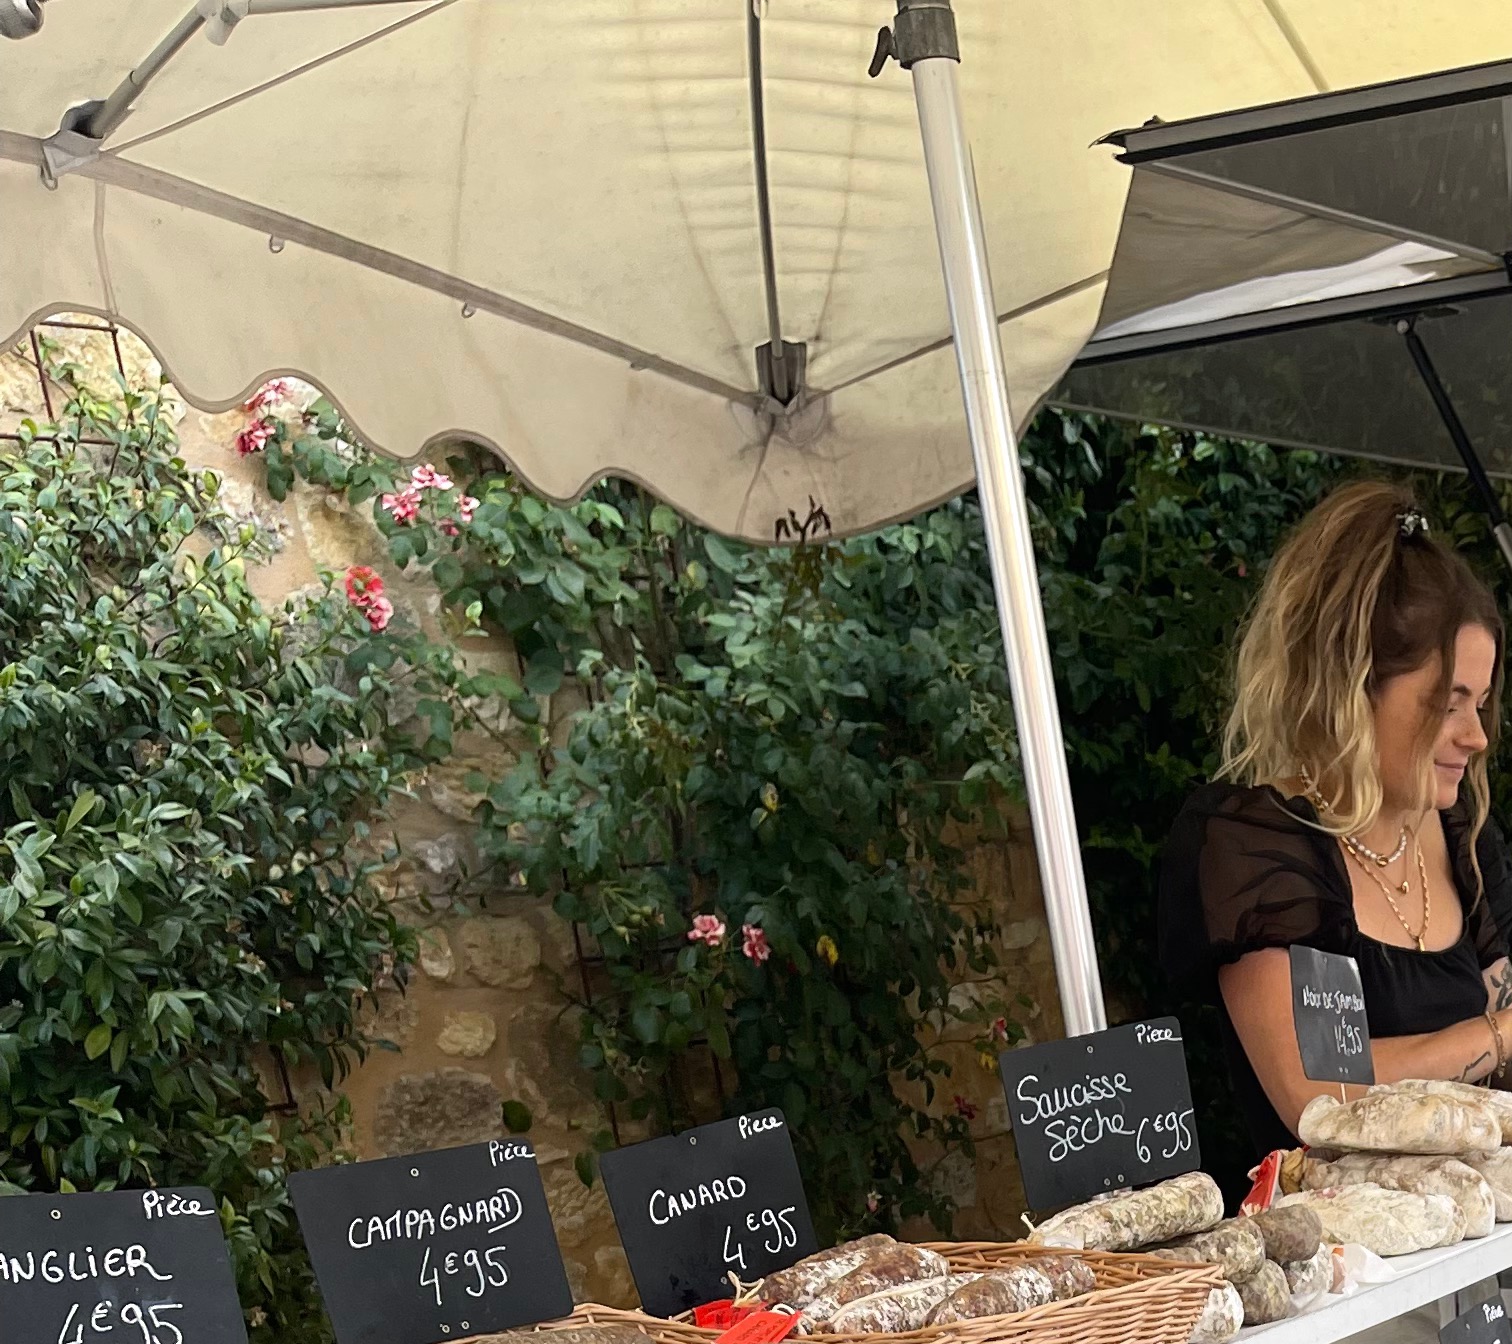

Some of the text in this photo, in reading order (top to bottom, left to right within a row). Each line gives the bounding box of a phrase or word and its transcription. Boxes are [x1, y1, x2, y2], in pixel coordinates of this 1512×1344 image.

[1017, 1072, 1132, 1125] Saucisse
[1044, 1108, 1136, 1162] Sèche
[348, 1187, 523, 1248] CAMPAGNARD
[650, 1175, 746, 1225] CANARD
[723, 1206, 797, 1269] 4€95
[420, 1246, 508, 1305] 4€95
